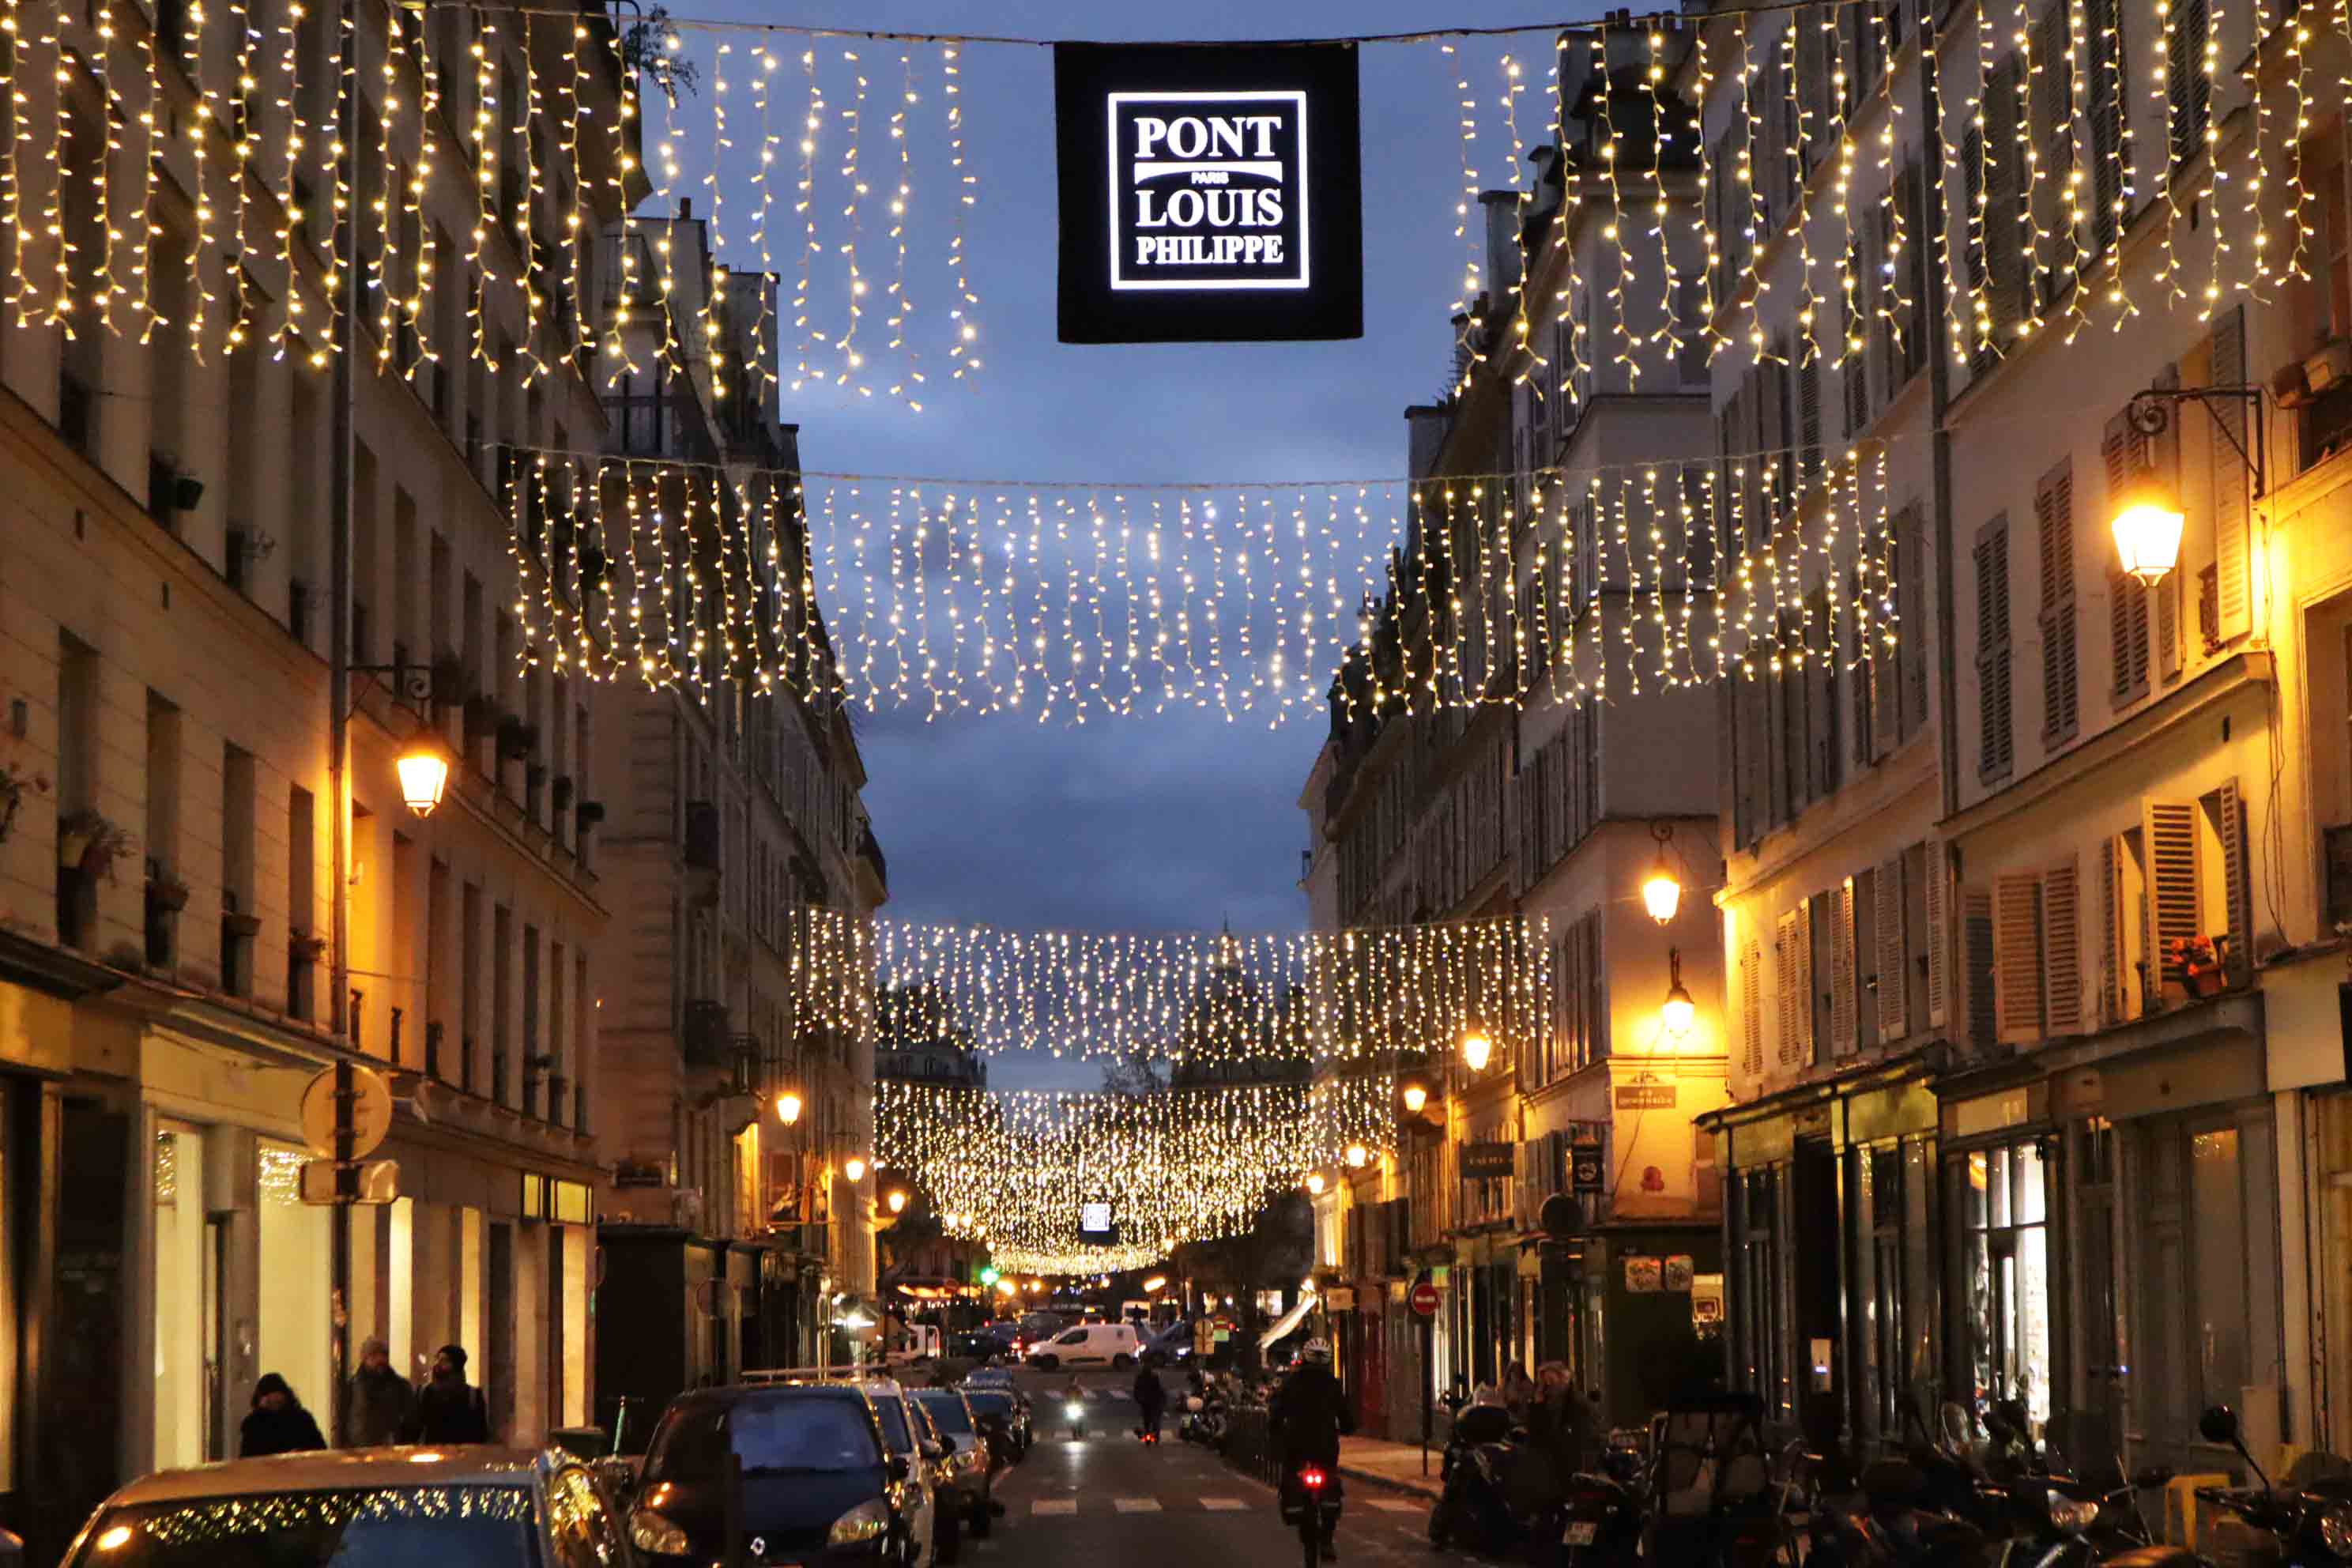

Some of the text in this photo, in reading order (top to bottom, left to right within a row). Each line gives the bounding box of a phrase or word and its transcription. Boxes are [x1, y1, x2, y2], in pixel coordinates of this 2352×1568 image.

[1134, 116, 1281, 158] PONT
[1191, 172, 1229, 184] PARIS
[1135, 188, 1283, 227] LOUIS
[1136, 236, 1283, 264] PHILIPPE
